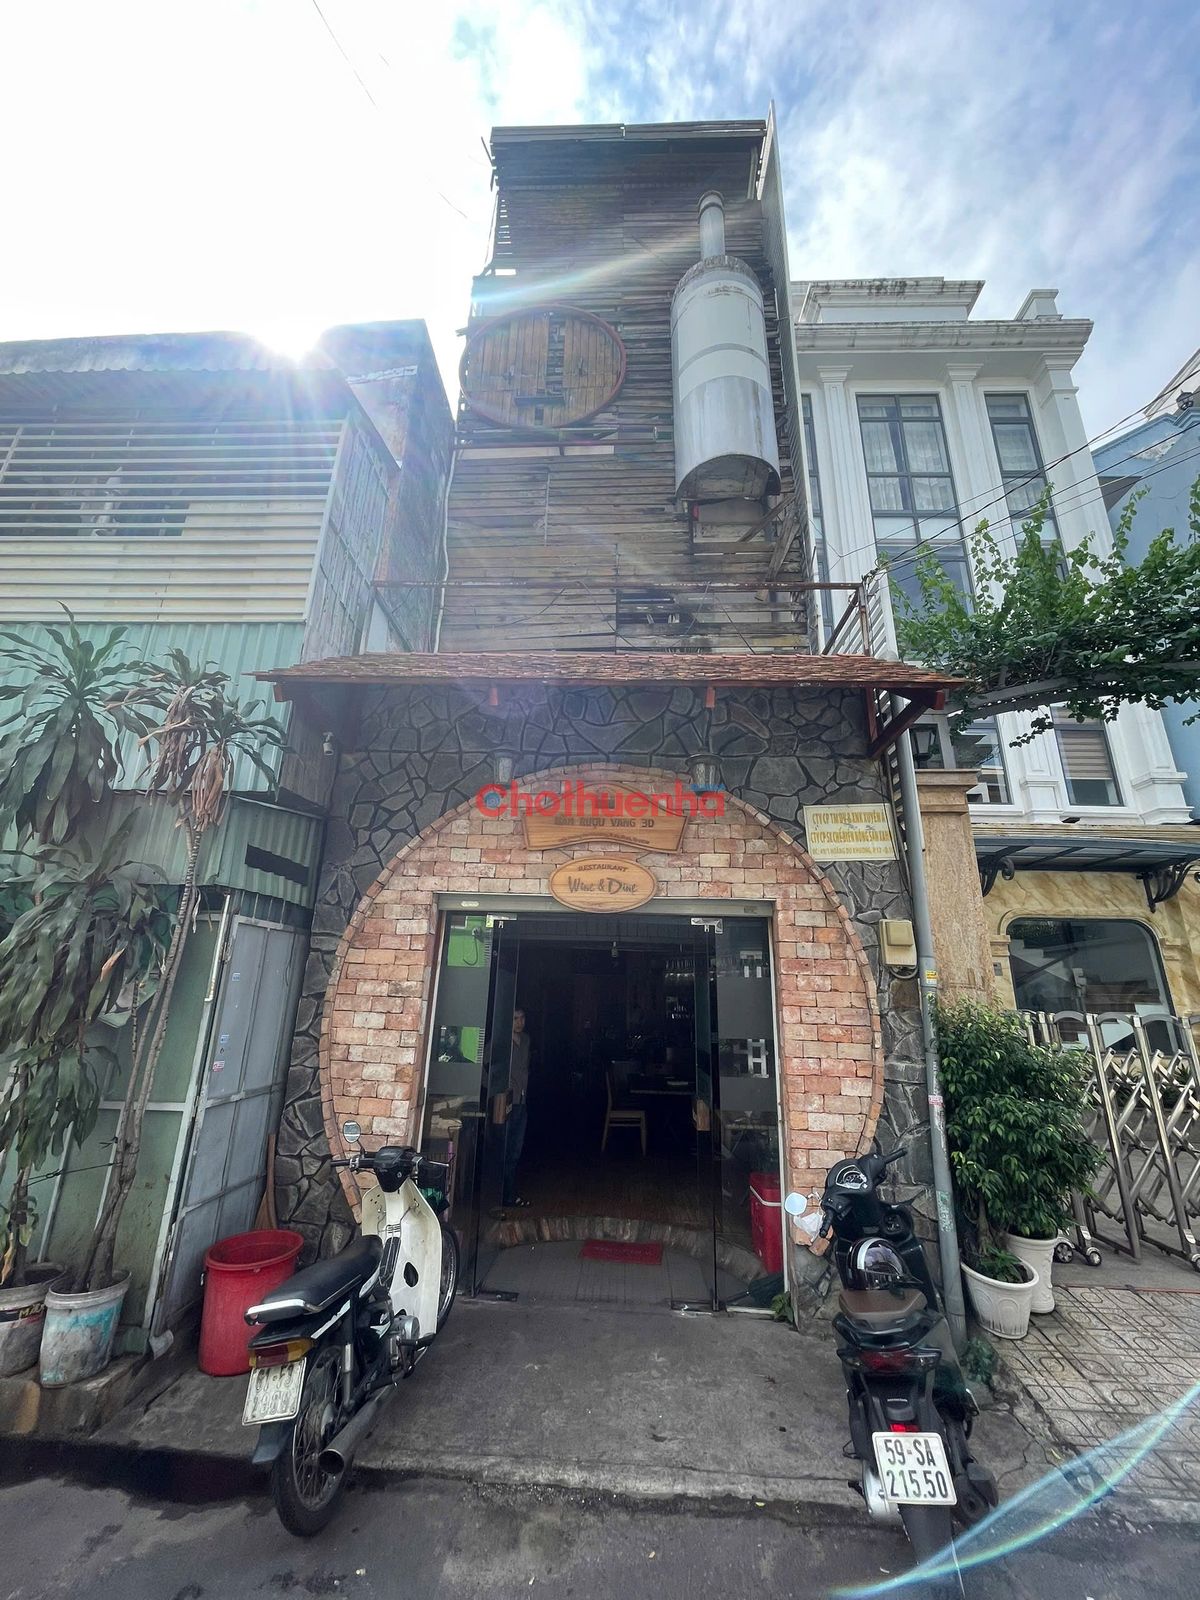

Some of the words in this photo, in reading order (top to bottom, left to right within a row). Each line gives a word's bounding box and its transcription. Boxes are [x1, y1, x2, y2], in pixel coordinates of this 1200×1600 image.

[611, 817, 636, 828] VANG
[823, 812, 830, 824] CP
[578, 863, 628, 872] RESTAURANT
[568, 876, 594, 893] Wine
[598, 878, 605, 891] &
[606, 877, 638, 894] Dine
[884, 1439, 936, 1466] 59-SA
[886, 1470, 949, 1498] 215.50
